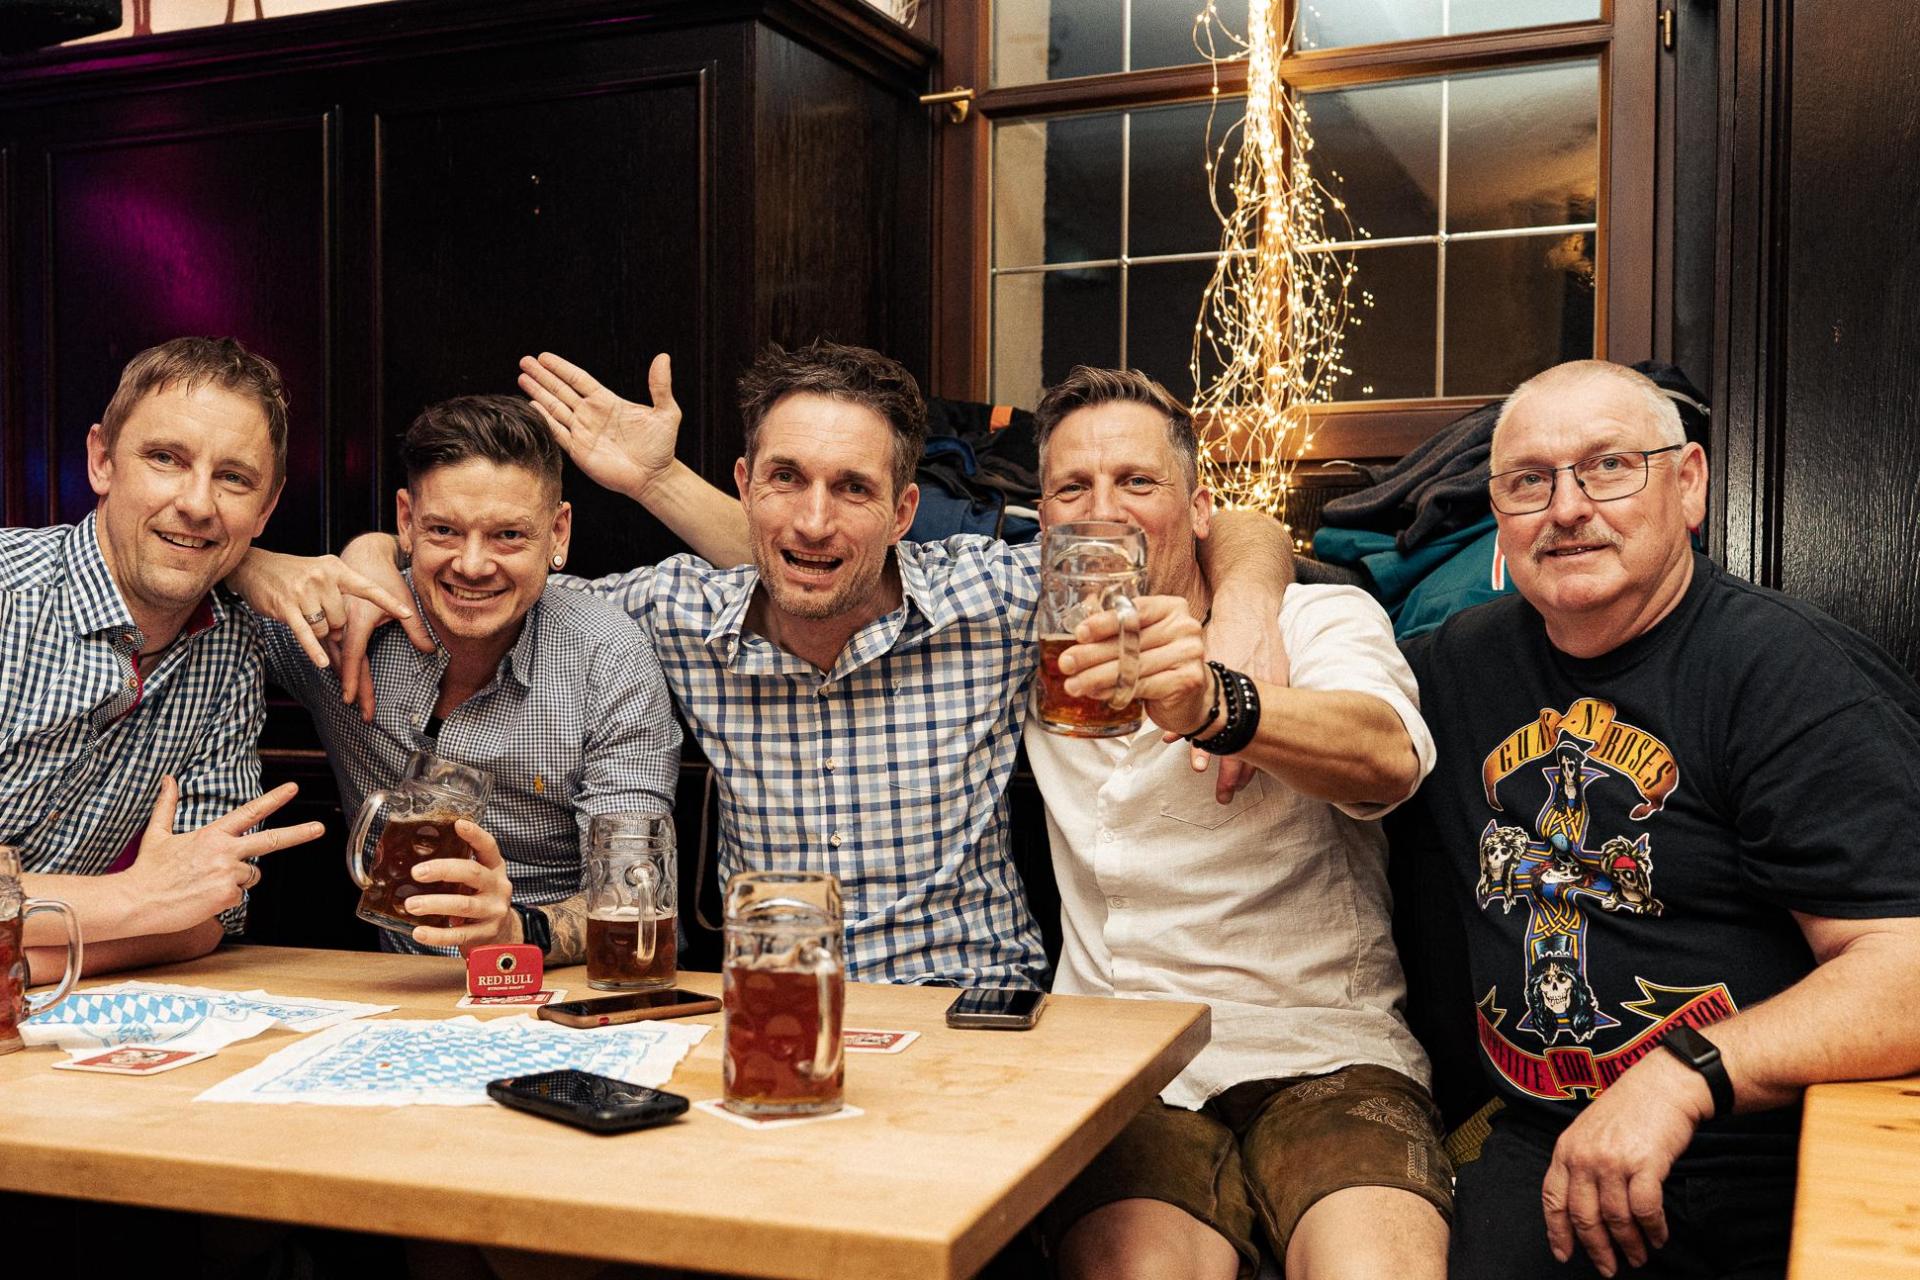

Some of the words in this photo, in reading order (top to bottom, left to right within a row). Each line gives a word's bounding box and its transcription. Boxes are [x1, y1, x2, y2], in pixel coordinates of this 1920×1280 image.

[1599, 727, 1674, 790] ROSES
[477, 975, 503, 986] RED
[504, 973, 534, 985] BULL
[1551, 1053, 1594, 1083] FOR
